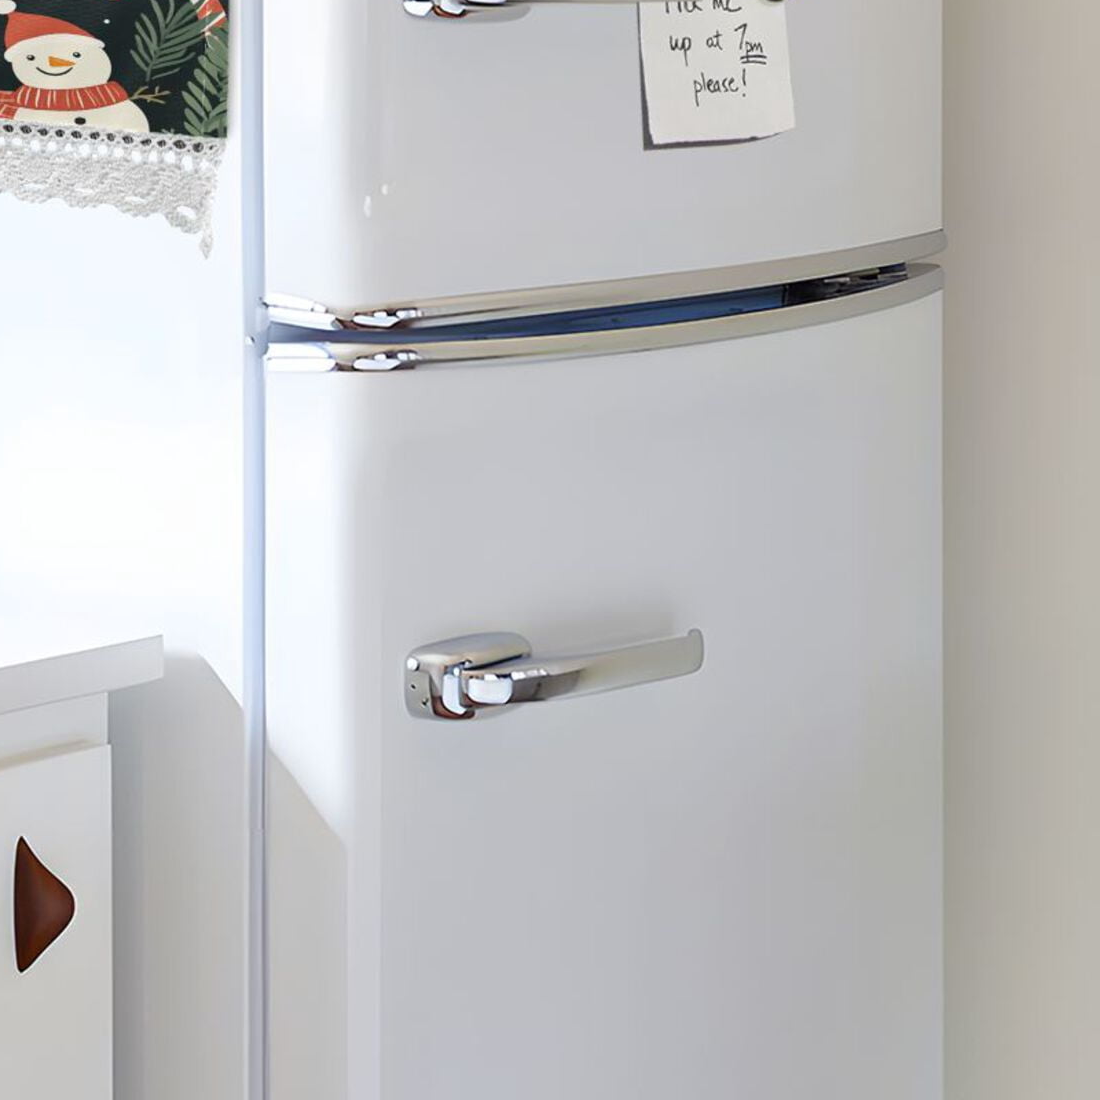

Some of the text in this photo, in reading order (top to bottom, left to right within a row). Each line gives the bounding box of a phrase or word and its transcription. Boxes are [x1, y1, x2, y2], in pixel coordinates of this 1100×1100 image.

[668, 35, 693, 68] up
[705, 29, 724, 51] at
[692, 67, 747, 108] please!
